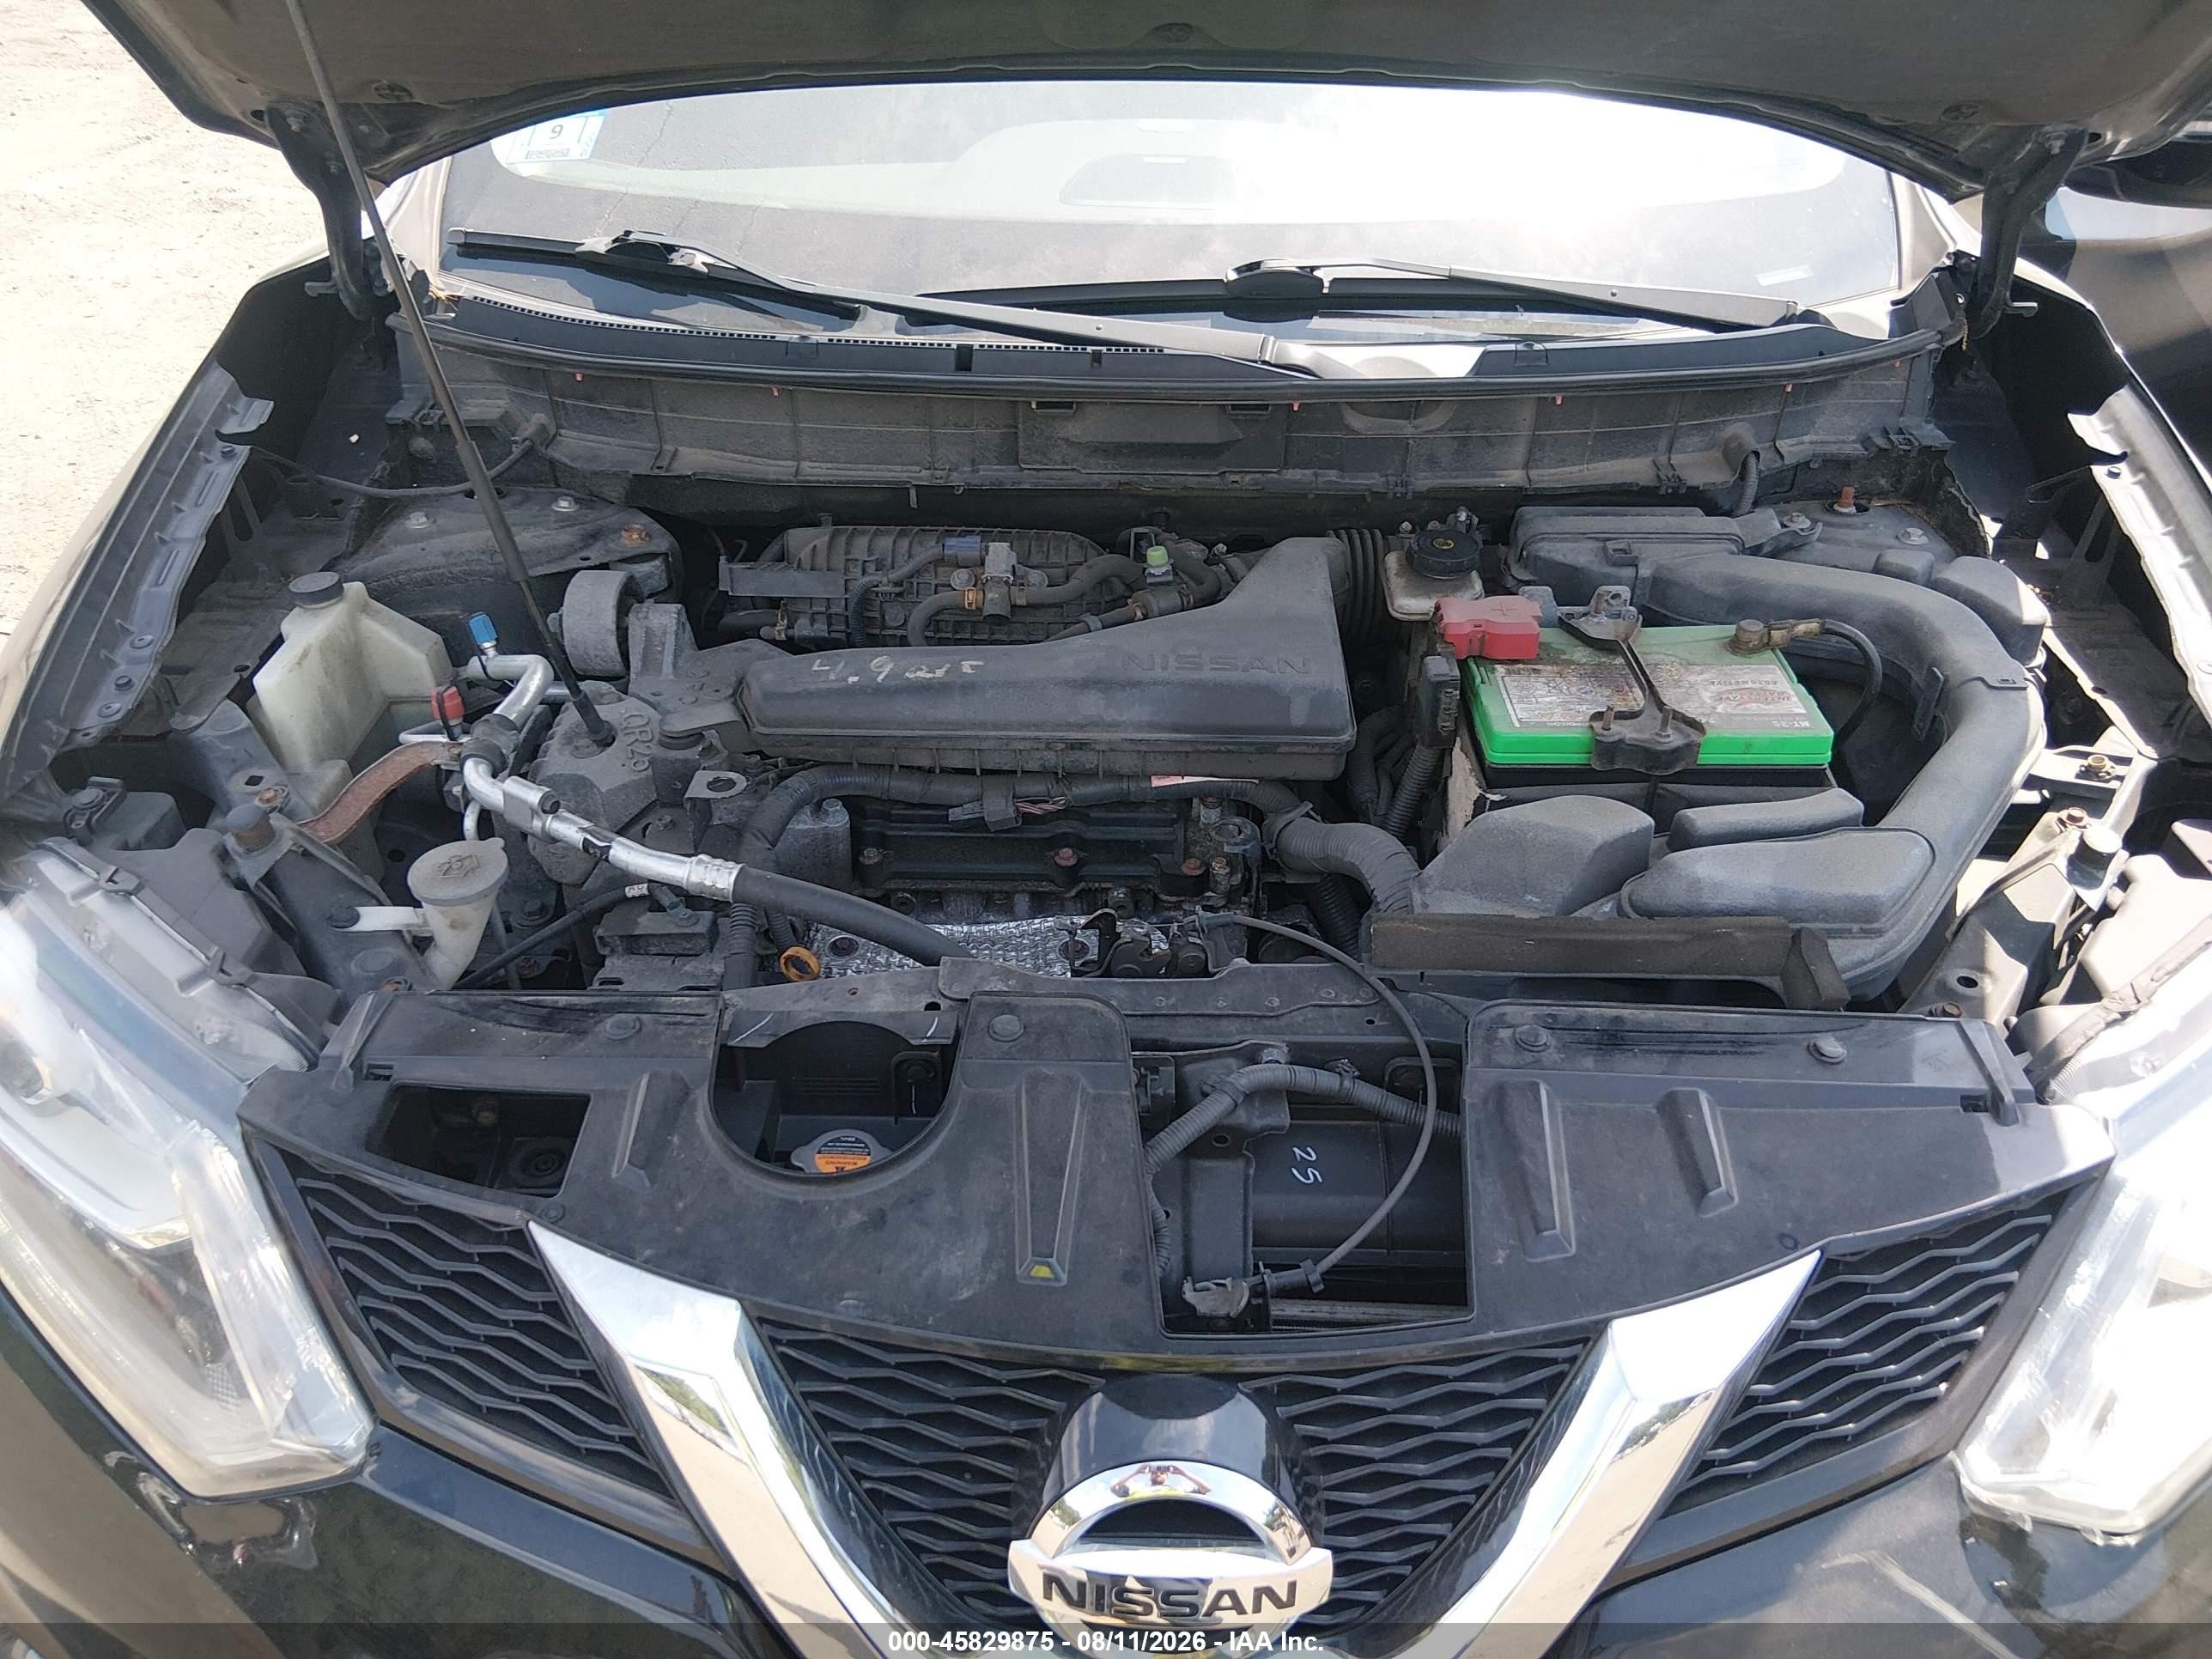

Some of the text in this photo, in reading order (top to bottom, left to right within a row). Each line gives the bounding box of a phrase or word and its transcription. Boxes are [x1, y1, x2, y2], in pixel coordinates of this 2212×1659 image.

[1121, 653, 1310, 675] NISSAN
[1291, 1146, 1323, 1184] 25
[1042, 1571, 1298, 1619] NISSAN
